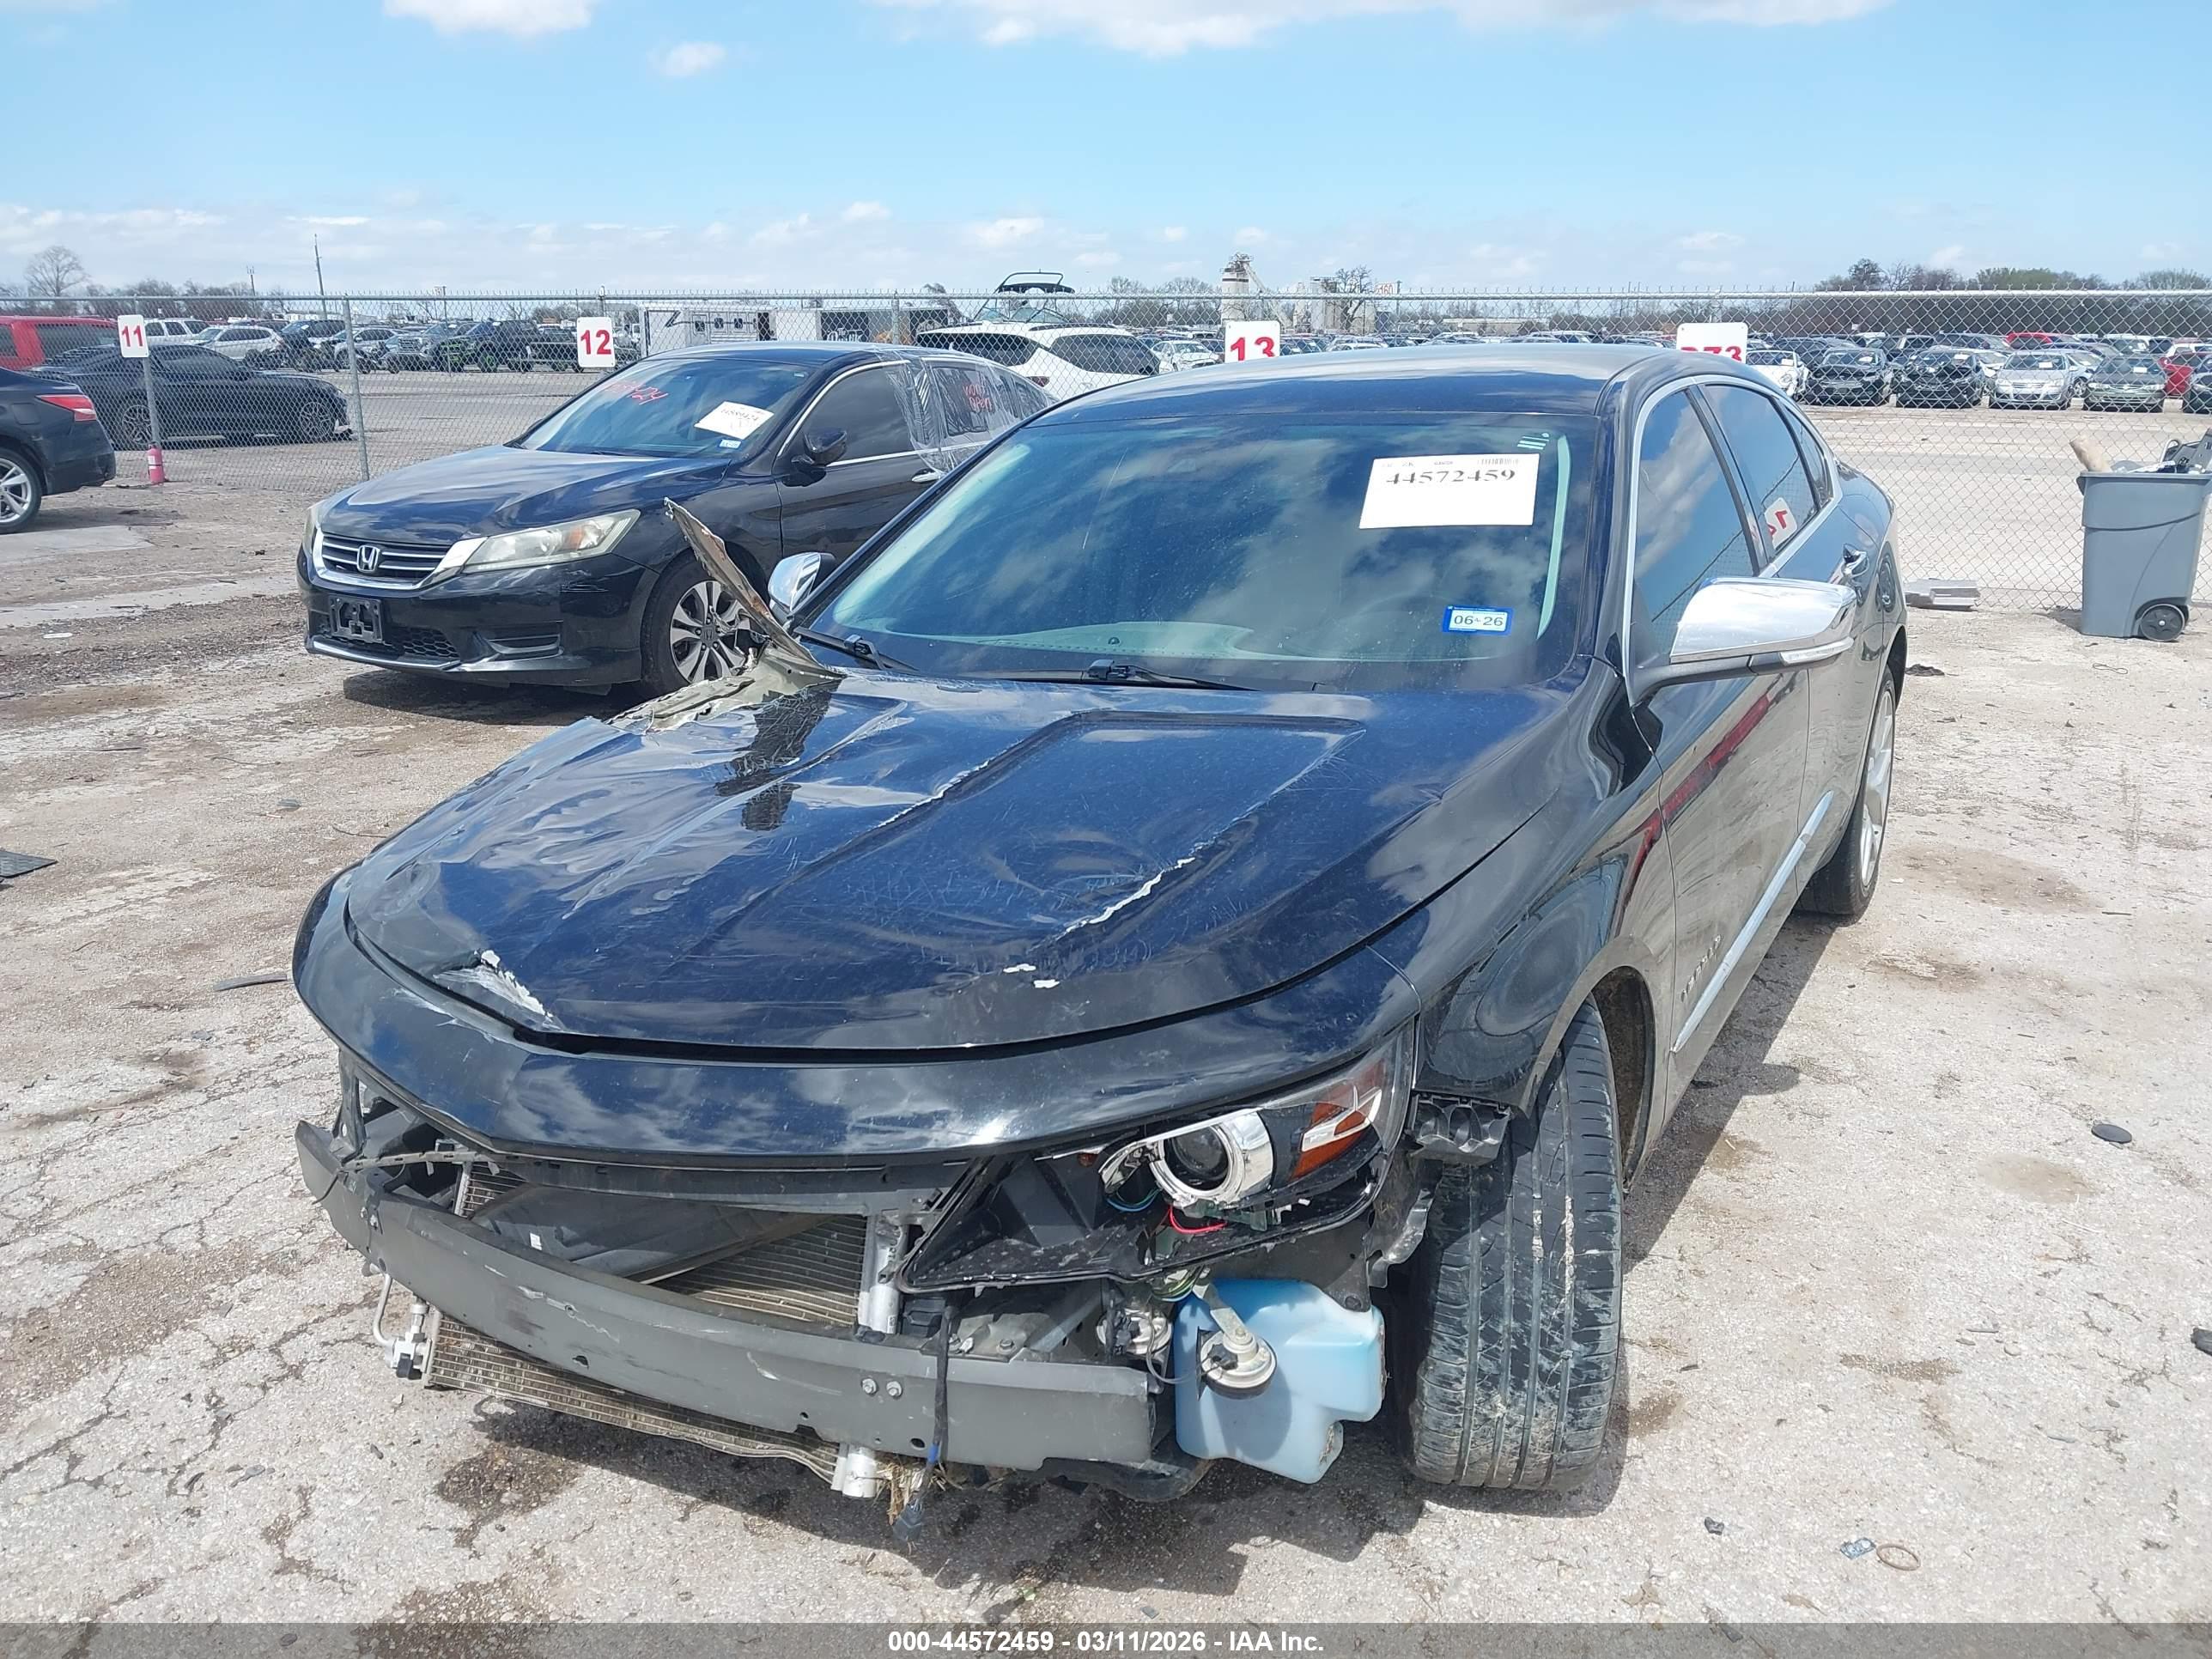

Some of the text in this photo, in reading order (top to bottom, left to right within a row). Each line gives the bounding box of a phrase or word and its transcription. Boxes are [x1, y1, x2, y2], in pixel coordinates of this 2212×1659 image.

[121, 325, 143, 348] 11
[580, 329, 612, 356] 12
[1386, 469, 1516, 485] 44572459
